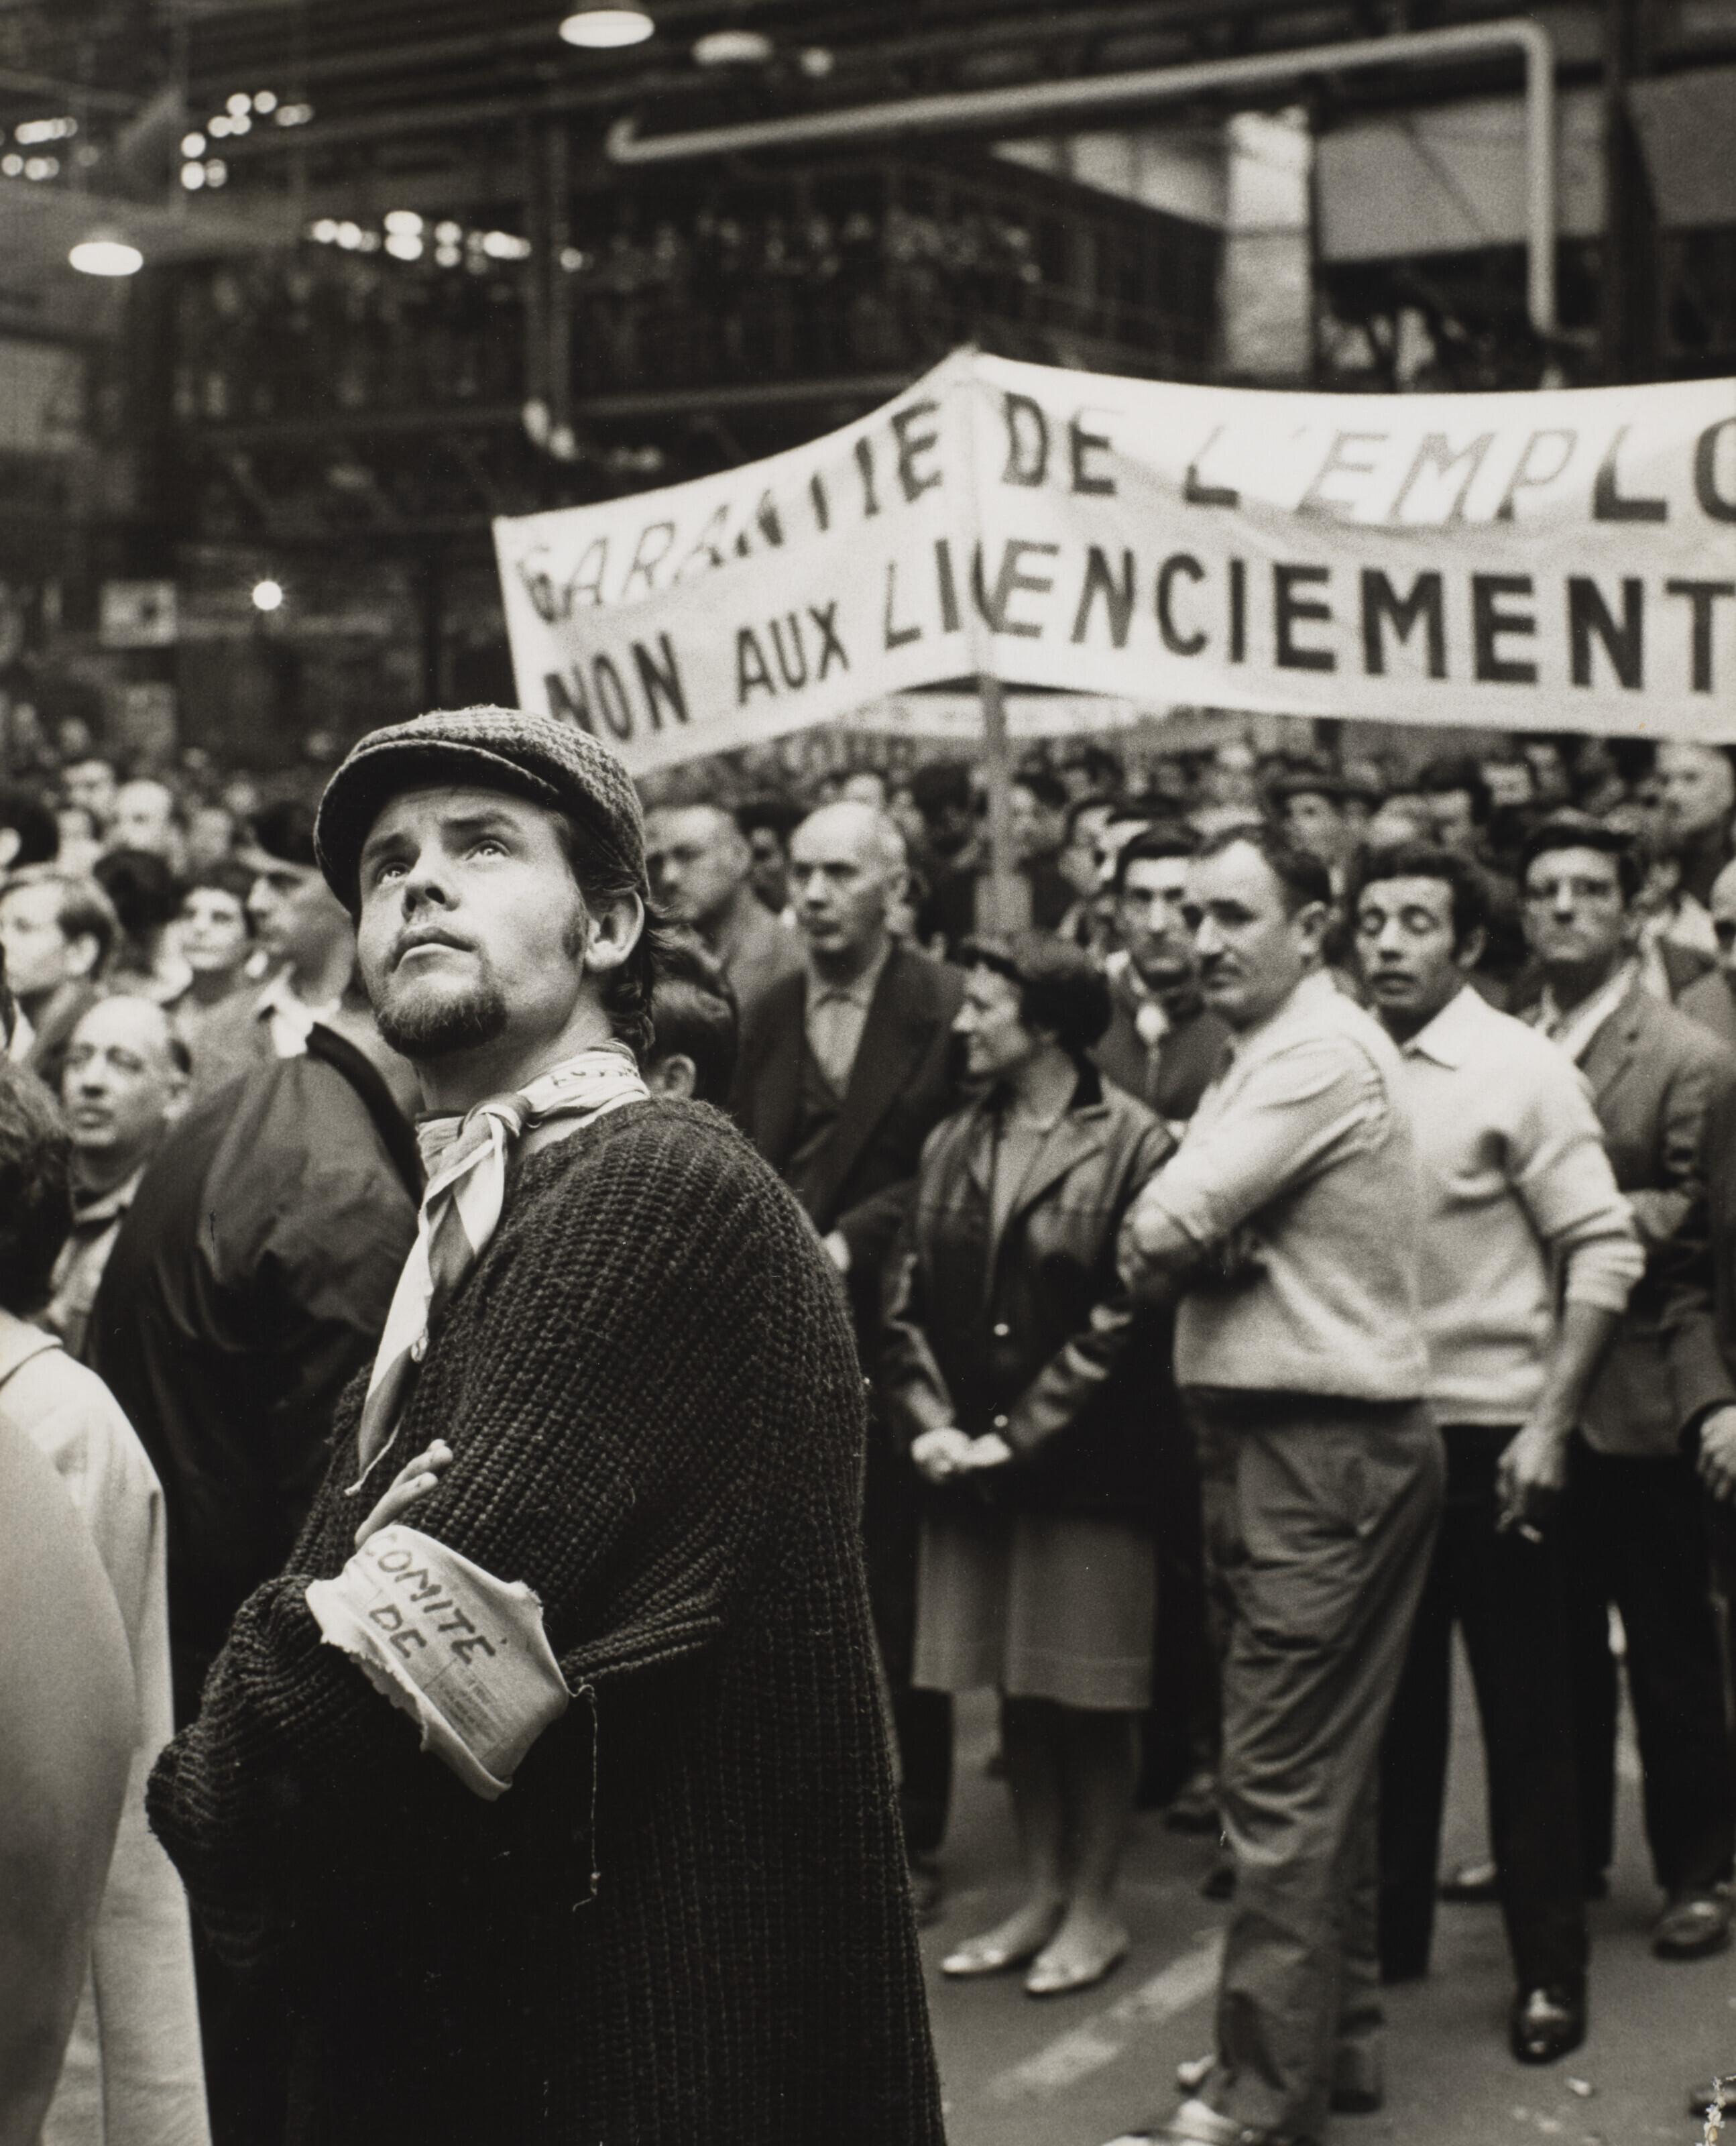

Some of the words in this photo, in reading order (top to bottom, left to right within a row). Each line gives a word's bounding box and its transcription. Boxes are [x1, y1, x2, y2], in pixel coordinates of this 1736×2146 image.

[1002, 390, 1122, 496] DE
[542, 630, 689, 742] NON
[736, 600, 850, 708] AUX
[368, 1603, 428, 1658] DE
